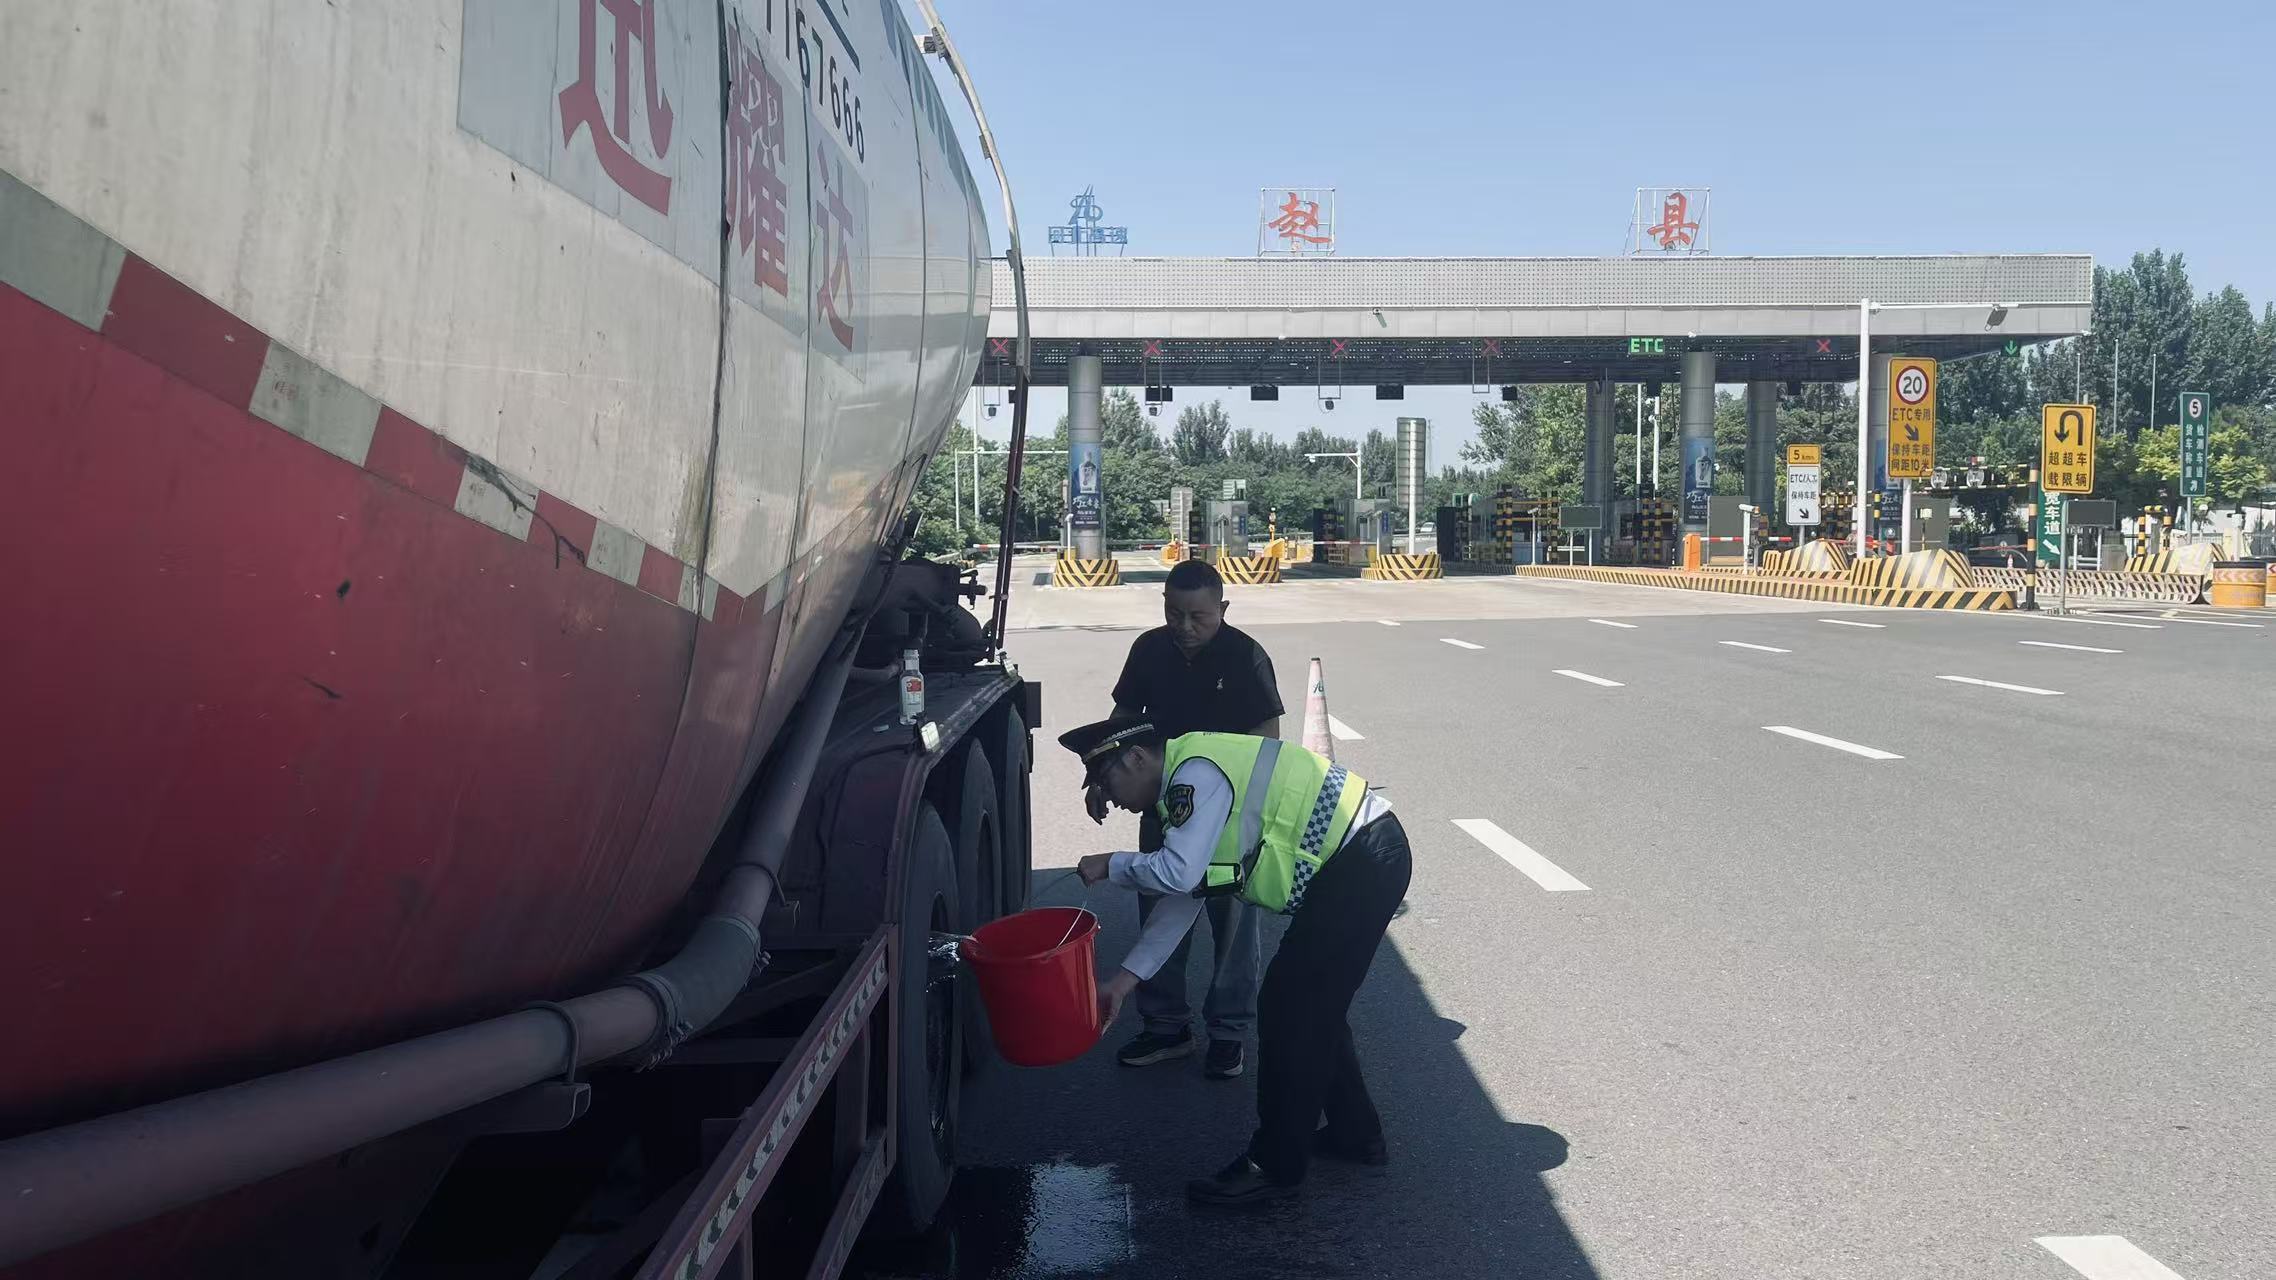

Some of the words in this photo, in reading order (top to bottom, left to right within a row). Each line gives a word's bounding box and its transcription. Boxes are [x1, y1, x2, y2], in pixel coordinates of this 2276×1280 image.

[1268, 191, 1332, 243] 赵
[1646, 191, 1699, 246] 县
[1631, 338, 1664, 353] ETC
[1903, 375, 1922, 395] 20
[1892, 407, 1931, 421] ETC专用
[2192, 401, 2199, 415] 5
[1793, 449, 1800, 461] 5
